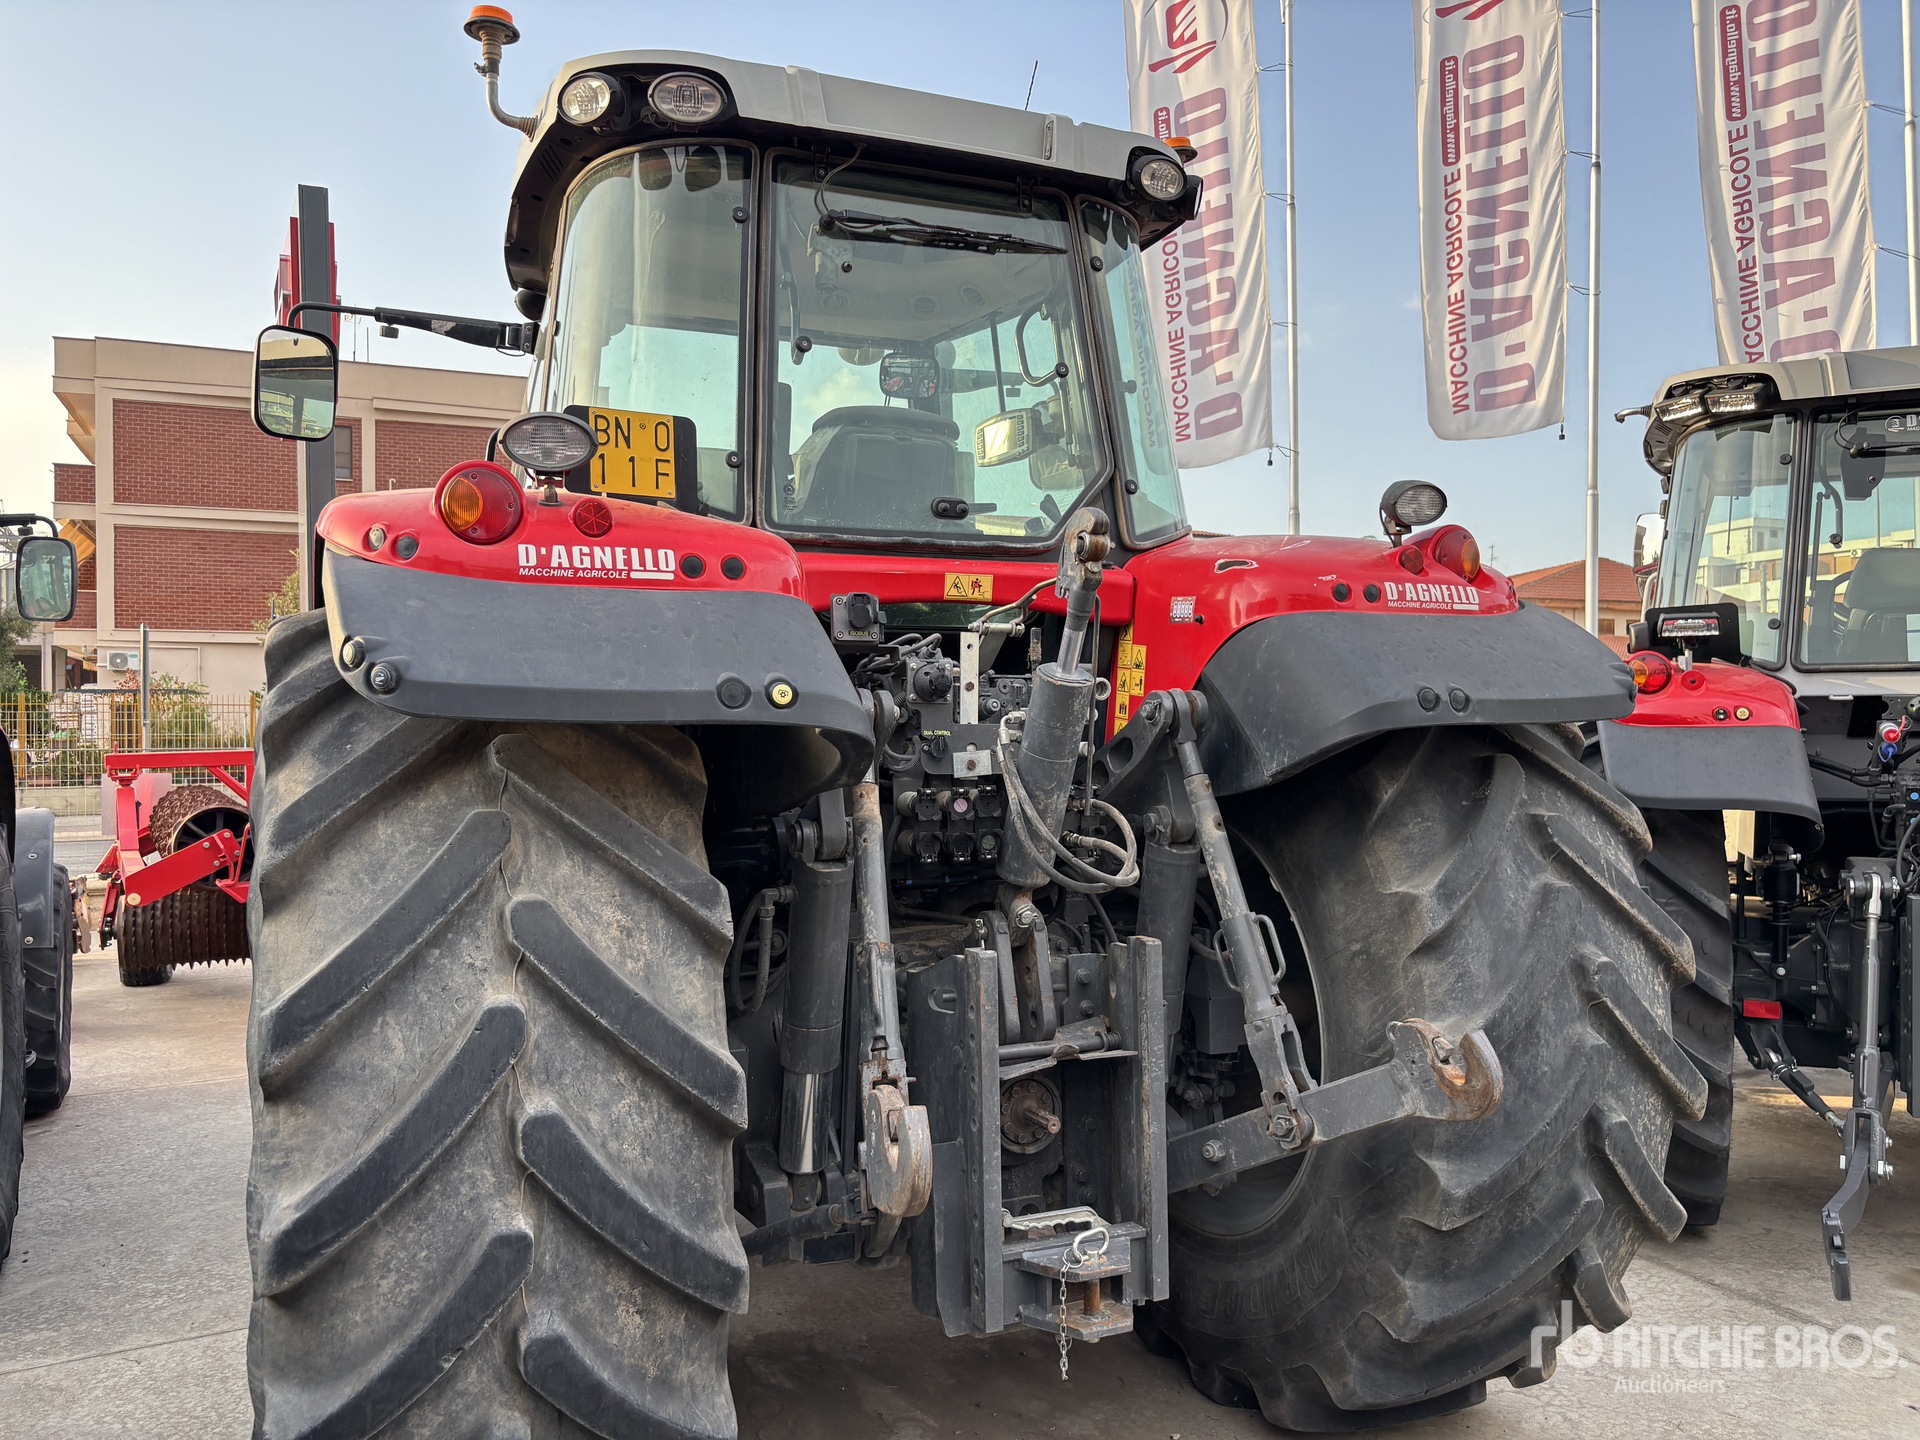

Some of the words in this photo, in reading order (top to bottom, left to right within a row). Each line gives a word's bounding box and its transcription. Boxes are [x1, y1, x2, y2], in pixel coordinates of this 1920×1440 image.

[594, 414, 631, 449] BN
[517, 543, 676, 571] D'AGNELLO
[518, 567, 574, 578] MACCHINE
[576, 569, 628, 579] AGRICOLE
[1383, 581, 1480, 604] D'AGNELLO
[1387, 600, 1421, 609] MACCHINE
[1421, 602, 1452, 610] AGRICOLE
